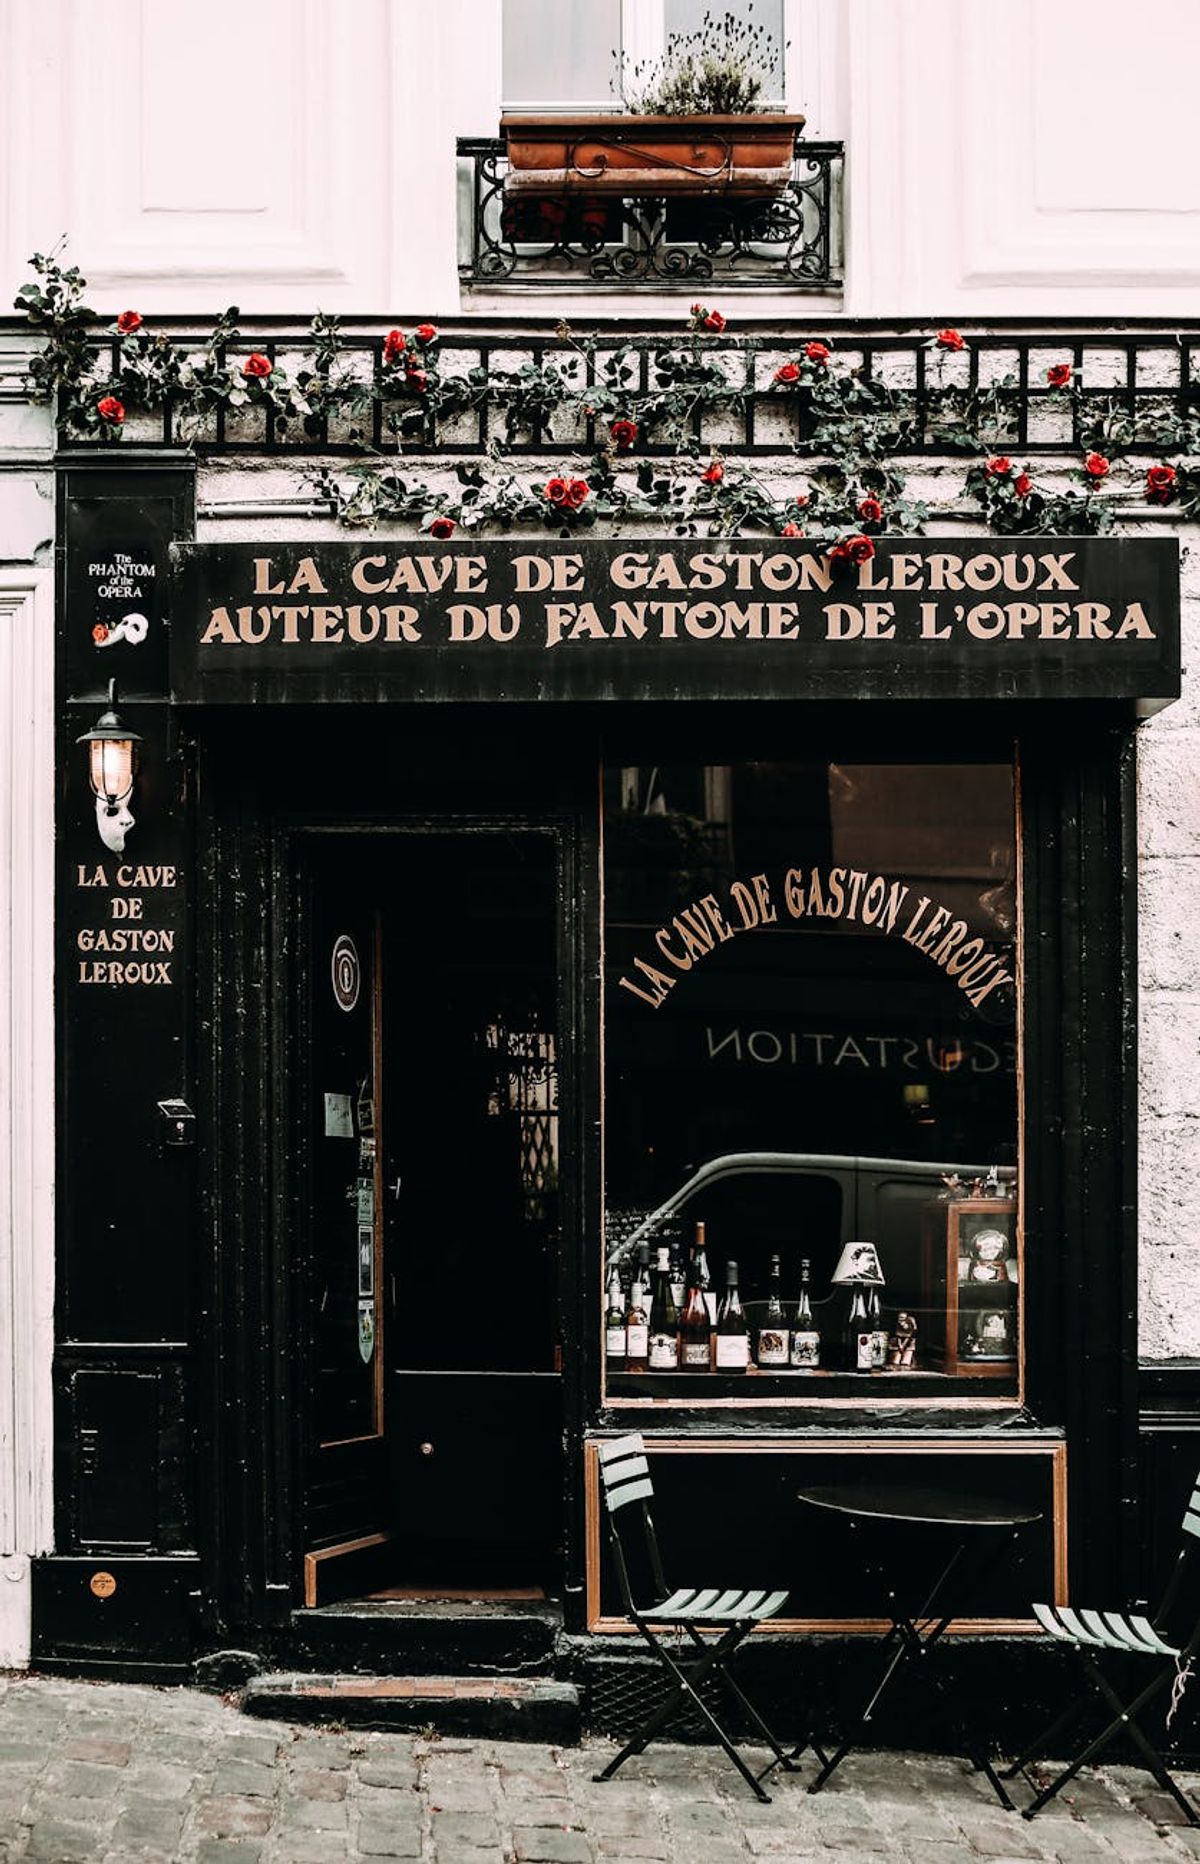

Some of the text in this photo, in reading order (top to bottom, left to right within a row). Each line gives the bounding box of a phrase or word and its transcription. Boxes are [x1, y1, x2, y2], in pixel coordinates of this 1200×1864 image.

[114, 554, 132, 563] The
[88, 564, 155, 577] PHANTOM
[110, 576, 134, 585] of the
[253, 552, 1079, 594] LA CAVE DE GASTON LEROUX
[98, 585, 142, 598] OPERA
[200, 602, 1156, 648] AUTEUR DU FANTOME DE L'OPERA
[78, 865, 176, 888] LA CAVE
[111, 898, 143, 919] DE
[78, 929, 175, 952] GASTON
[619, 867, 1013, 1008] LA CAVE DE GASTON LEROUX
[79, 962, 172, 984] LEROUX
